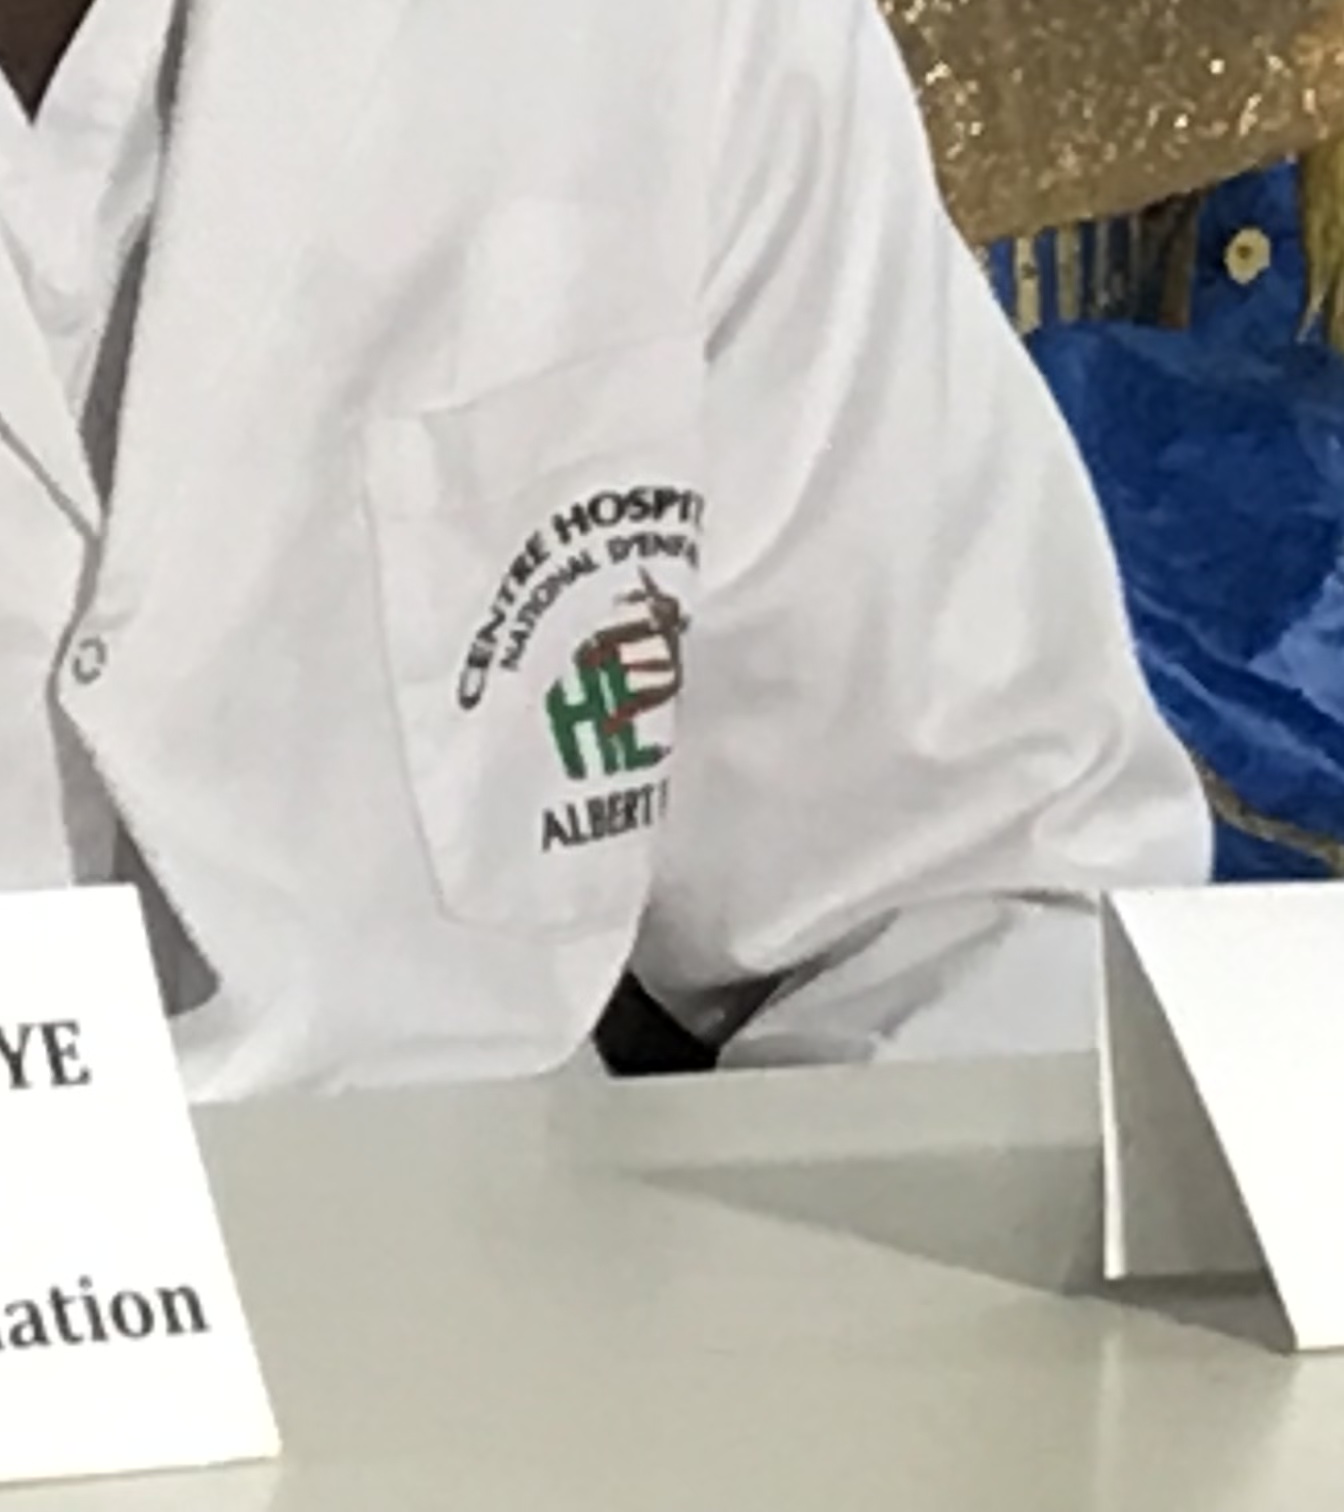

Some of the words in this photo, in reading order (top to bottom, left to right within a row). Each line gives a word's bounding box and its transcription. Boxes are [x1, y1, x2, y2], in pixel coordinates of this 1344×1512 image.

[457, 531, 551, 710] CENTRE
[500, 551, 600, 672] NATIONAL
[542, 783, 655, 852] ALBERT
